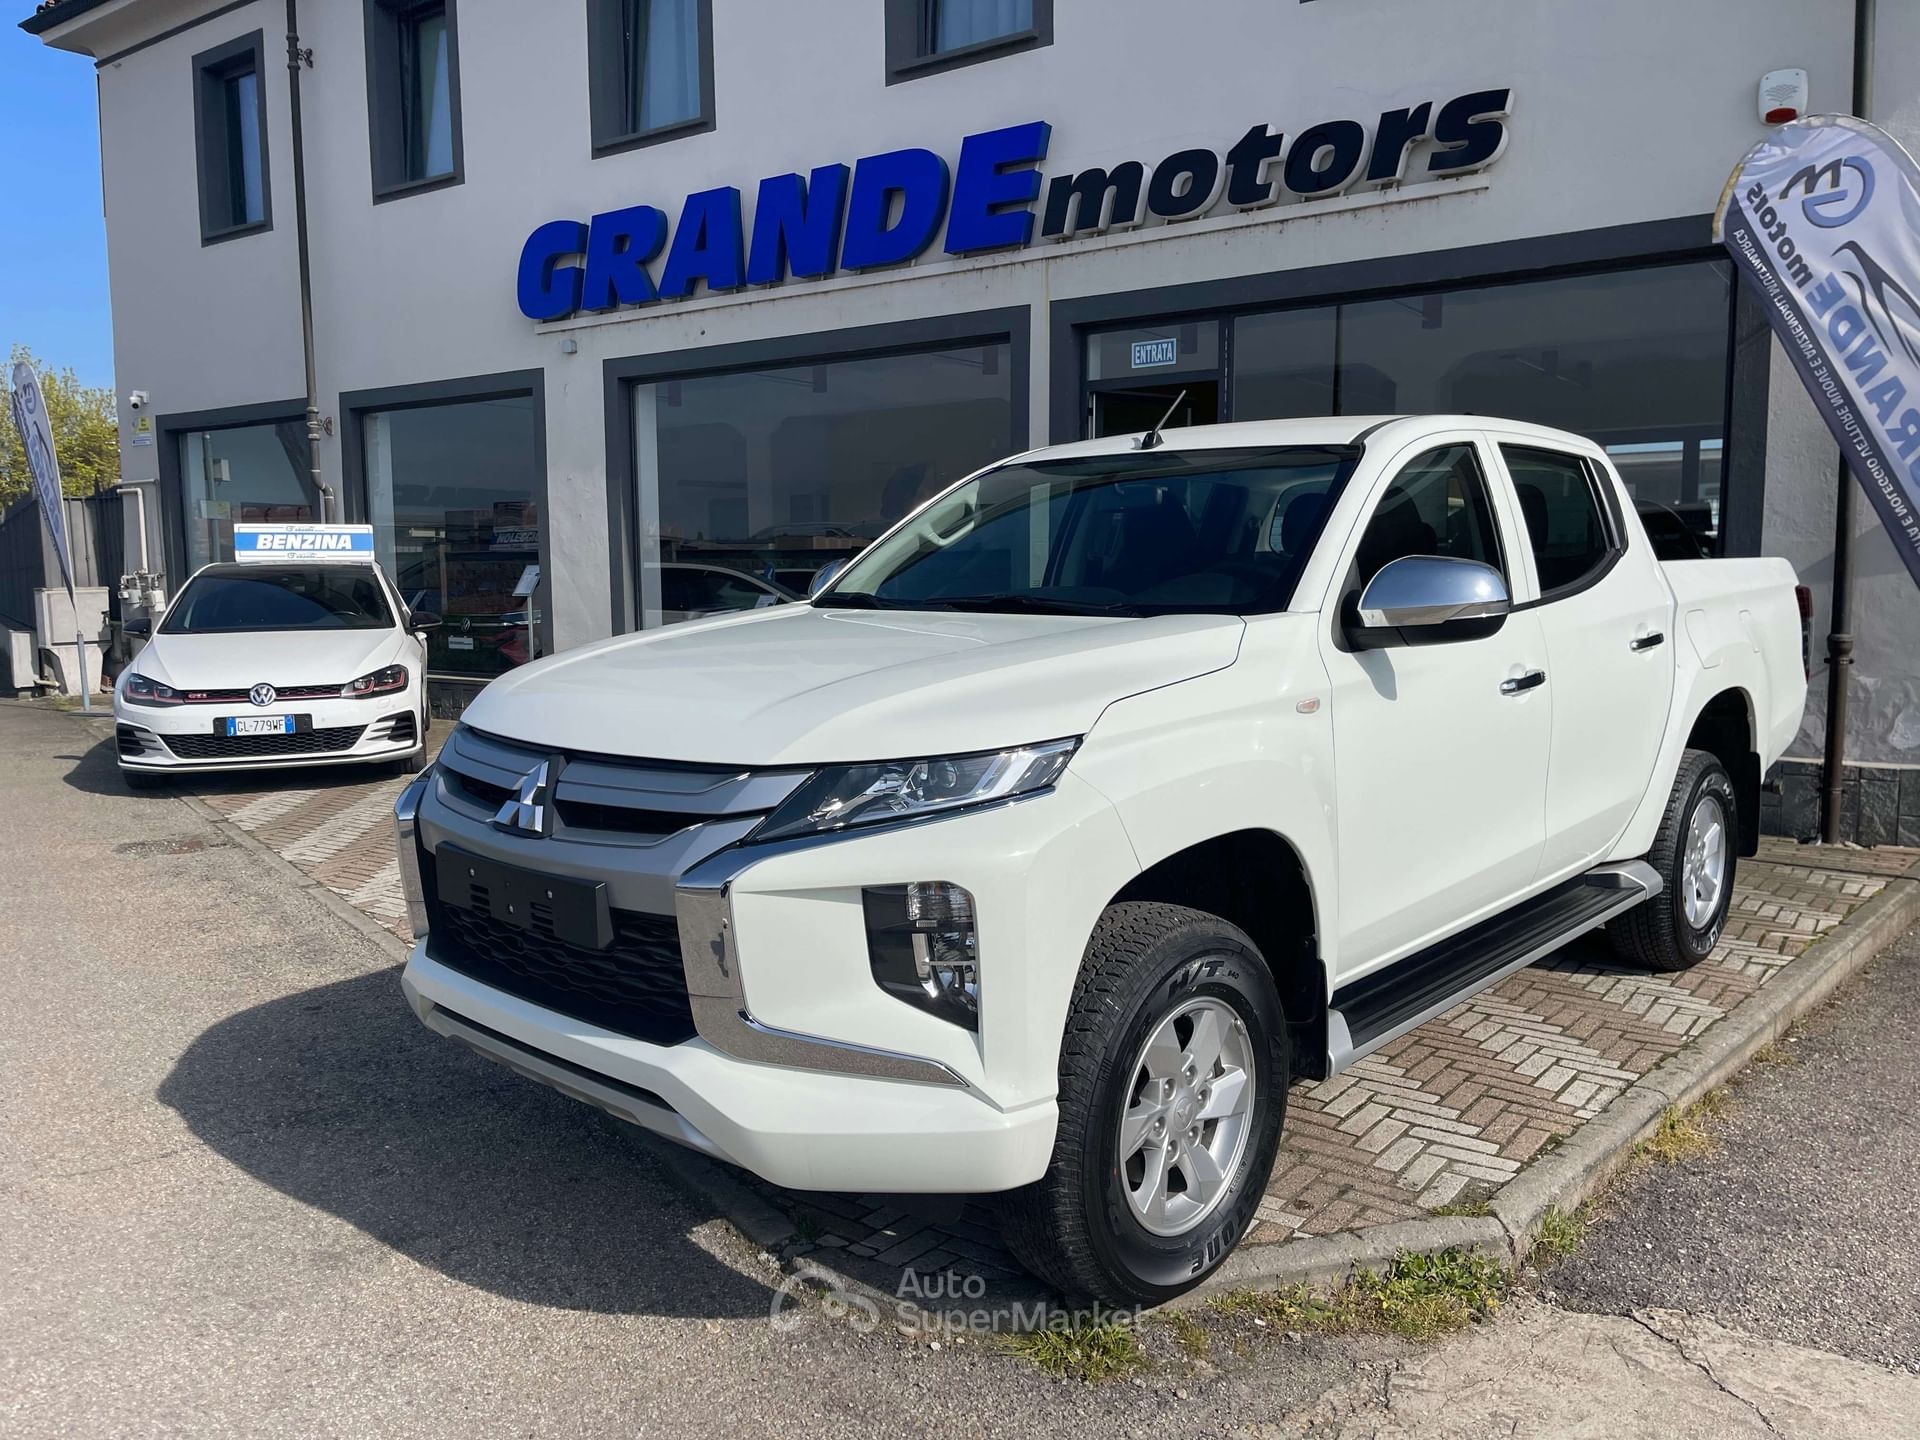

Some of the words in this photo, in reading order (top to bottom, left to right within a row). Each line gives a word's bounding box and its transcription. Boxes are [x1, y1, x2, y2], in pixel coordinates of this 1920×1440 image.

[517, 121, 1052, 321] GRANDE
[1041, 88, 1514, 240] motors
[1135, 342, 1173, 364] ENTRATA
[255, 534, 353, 550] BENZINA
[496, 530, 539, 545] NOLEGGI
